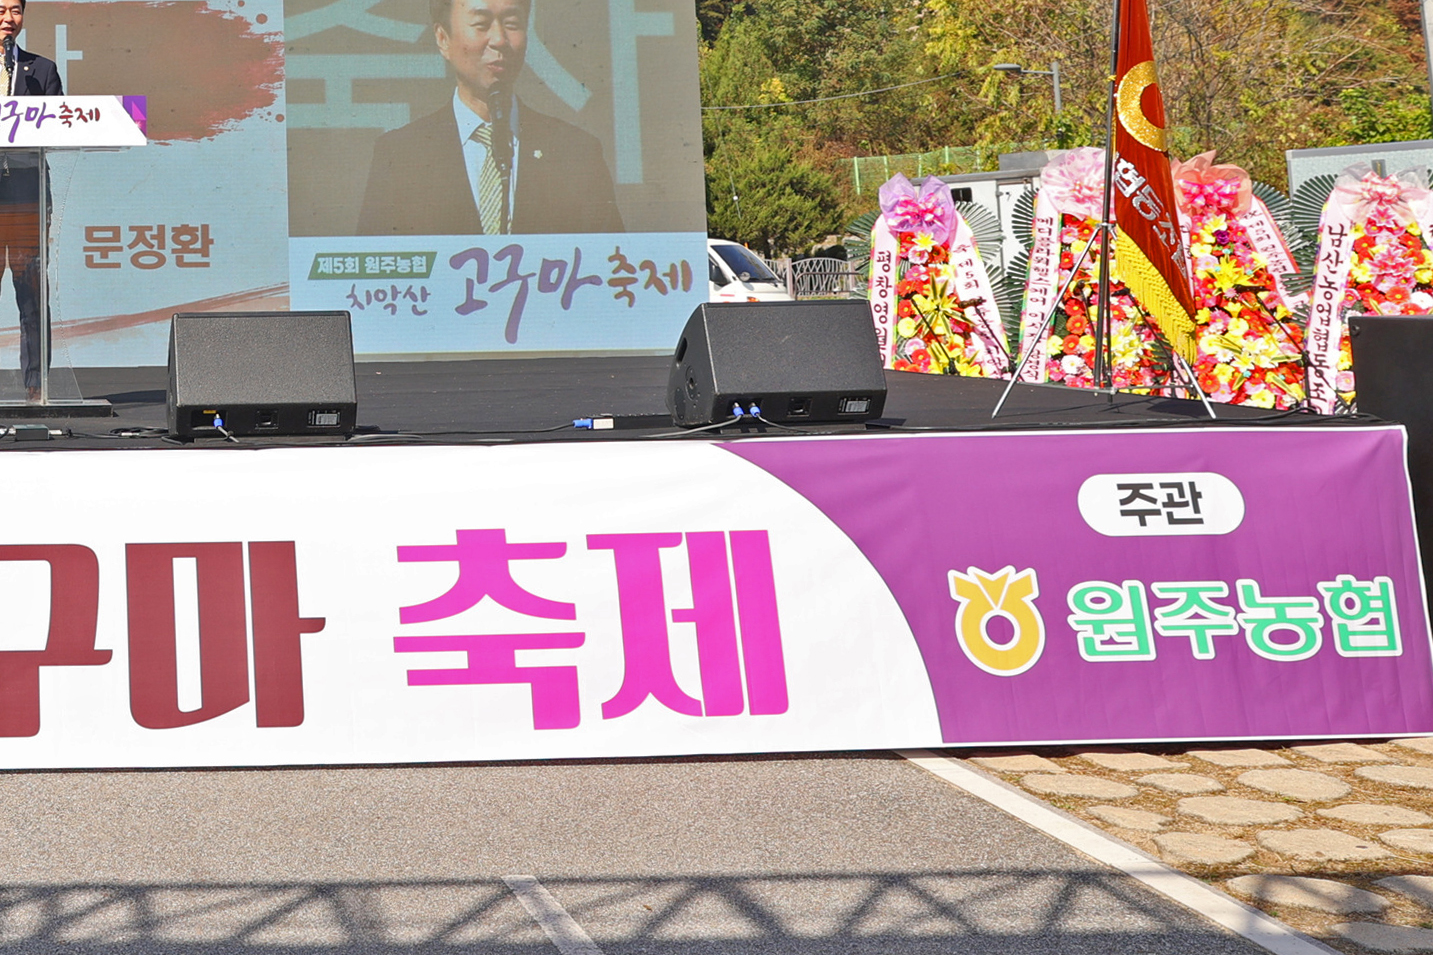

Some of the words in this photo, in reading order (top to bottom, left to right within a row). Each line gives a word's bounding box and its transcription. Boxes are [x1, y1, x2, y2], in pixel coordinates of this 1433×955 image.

[59, 101, 100, 128] 축제
[83, 224, 214, 270] 문정환
[318, 255, 359, 274] 제5회
[364, 254, 427, 274] 원주농협
[346, 283, 431, 316] 치악산
[449, 244, 603, 345] 고구마
[607, 246, 693, 308] 축제
[1117, 481, 1203, 527] 주관
[392, 528, 790, 730] 축제
[1067, 573, 1403, 663] 원주농협
